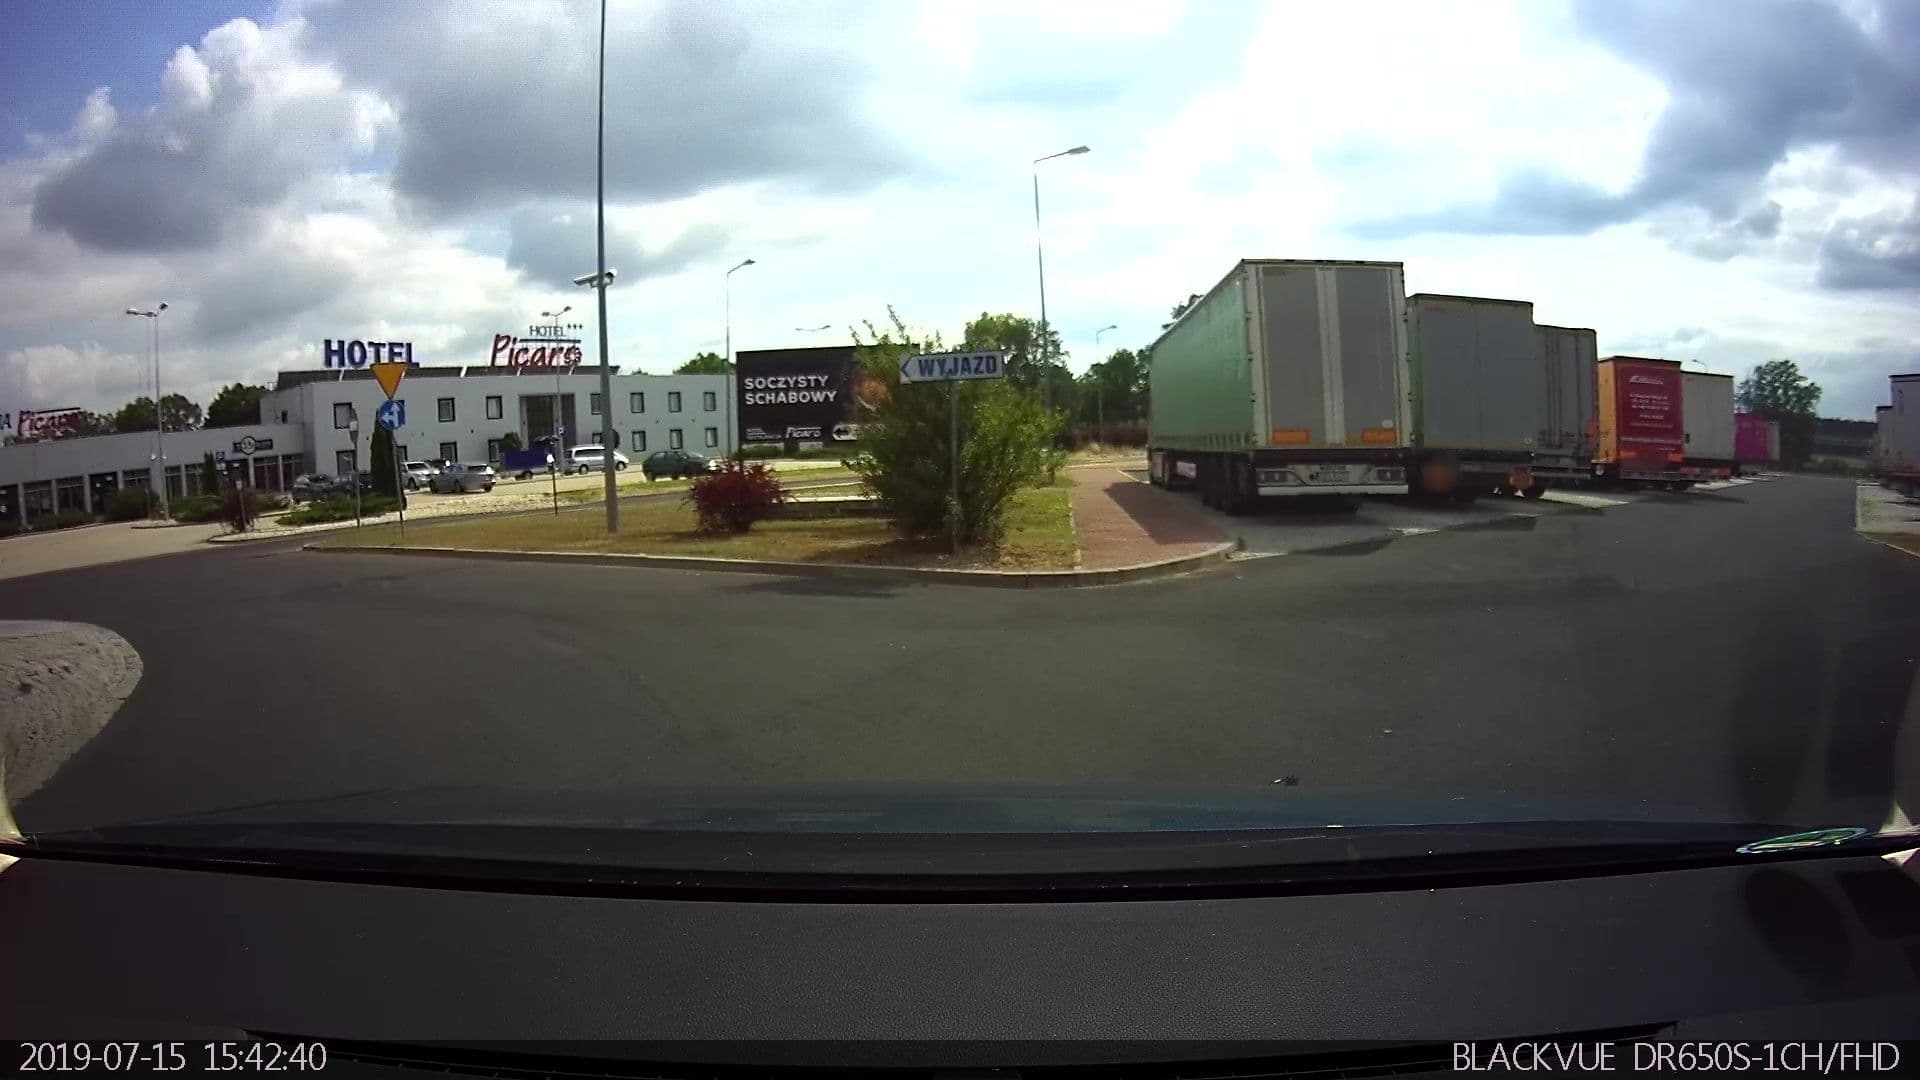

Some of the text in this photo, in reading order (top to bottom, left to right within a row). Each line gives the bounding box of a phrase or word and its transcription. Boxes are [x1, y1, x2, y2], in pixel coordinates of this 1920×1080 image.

[529, 325, 565, 337] HOTEL
[324, 339, 420, 370] HOTEL
[490, 333, 583, 368] Picaro
[918, 355, 997, 377] WYJAZD
[745, 376, 829, 390] SOCZYSTY
[744, 390, 838, 406] SCHABOWY
